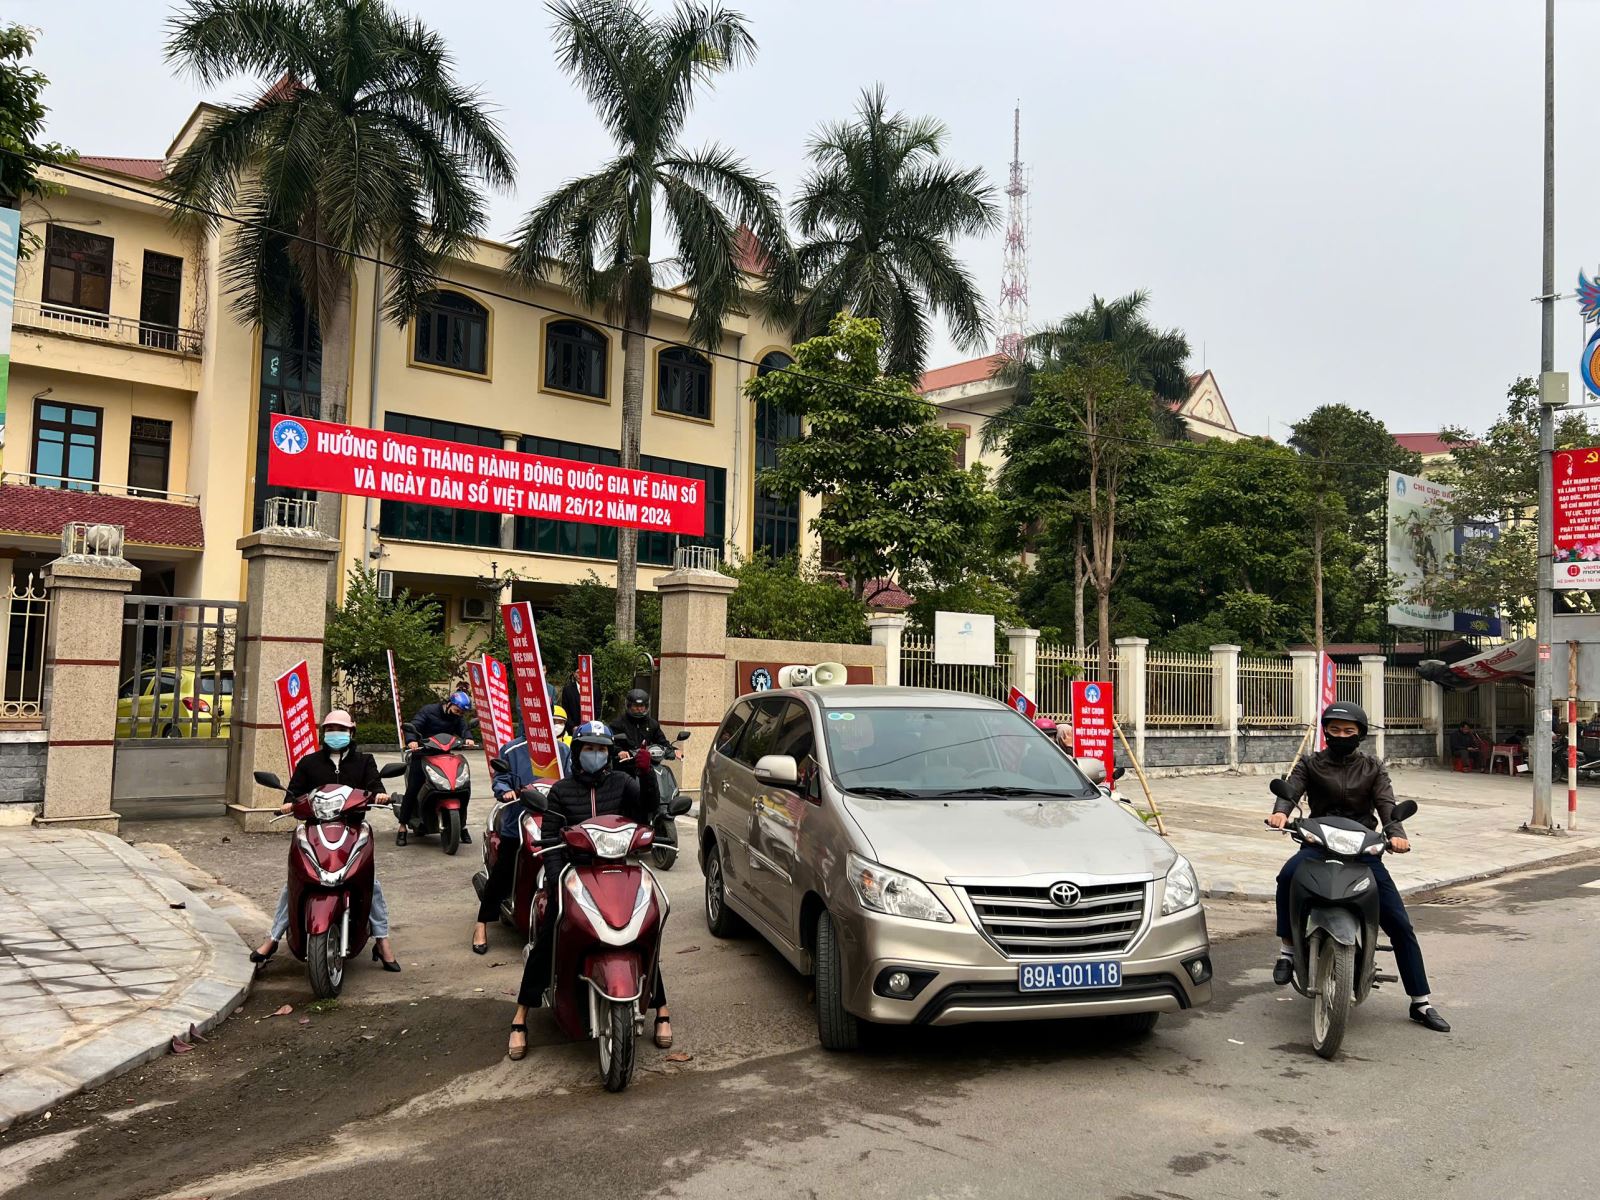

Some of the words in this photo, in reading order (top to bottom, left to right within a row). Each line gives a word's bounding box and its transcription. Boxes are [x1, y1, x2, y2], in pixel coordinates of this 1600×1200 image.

[317, 429, 378, 461] HƯỞNG
[382, 437, 417, 466] ỨNG
[422, 447, 474, 474] THÁNG
[478, 454, 520, 480] HÀNH
[523, 461, 563, 487] ĐỘNG
[567, 466, 604, 492] QUỐC
[607, 475, 629, 496] GIA
[632, 475, 649, 499] VỀ
[651, 480, 678, 502] DÂN
[680, 481, 698, 505] SỐ
[353, 465, 376, 490] VÀ
[380, 471, 426, 497] NGÀY
[430, 475, 465, 501] DÂN
[467, 479, 489, 504] SỐ
[492, 484, 525, 512] VIỆT
[527, 491, 562, 514] NAM
[565, 496, 604, 519] 26/12
[606, 500, 638, 522] NĂM
[640, 506, 672, 526] 2024
[1023, 963, 1118, 988] 89A-001.18
